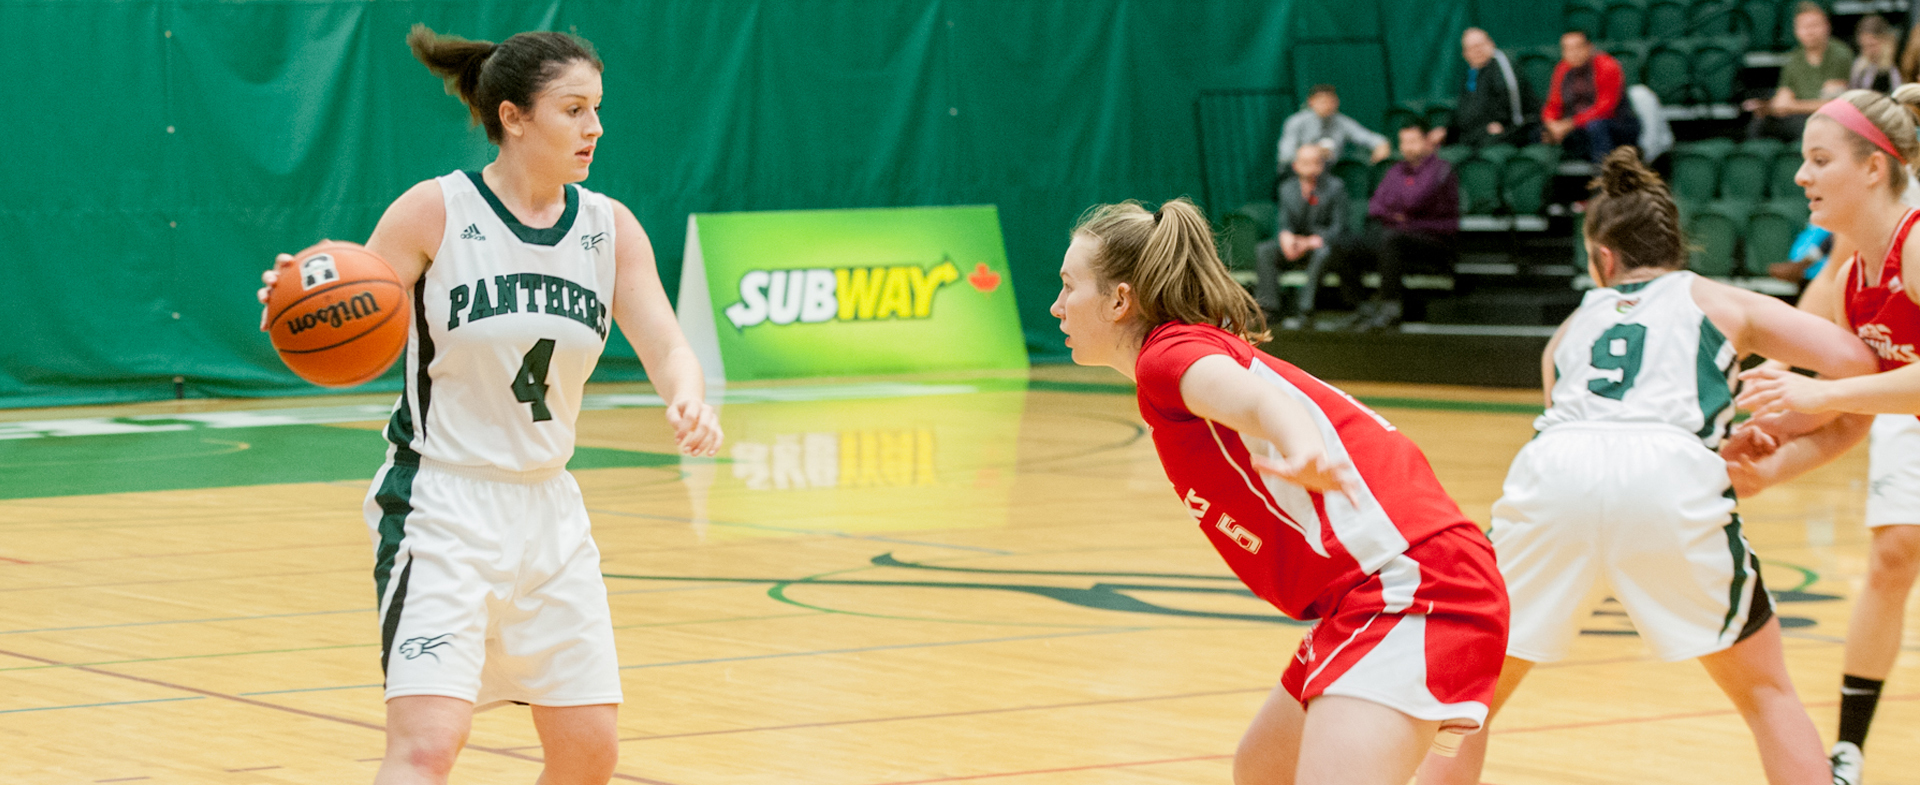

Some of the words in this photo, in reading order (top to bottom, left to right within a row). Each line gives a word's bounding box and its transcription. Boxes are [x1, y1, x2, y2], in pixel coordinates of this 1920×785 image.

[460, 232, 486, 241] adidas
[286, 291, 381, 335] Wilson
[448, 273, 607, 342] PANTHERS
[725, 259, 961, 331] SUBWAY
[511, 338, 556, 422] 4
[1587, 322, 1647, 400] 9
[1215, 512, 1263, 555] 5
